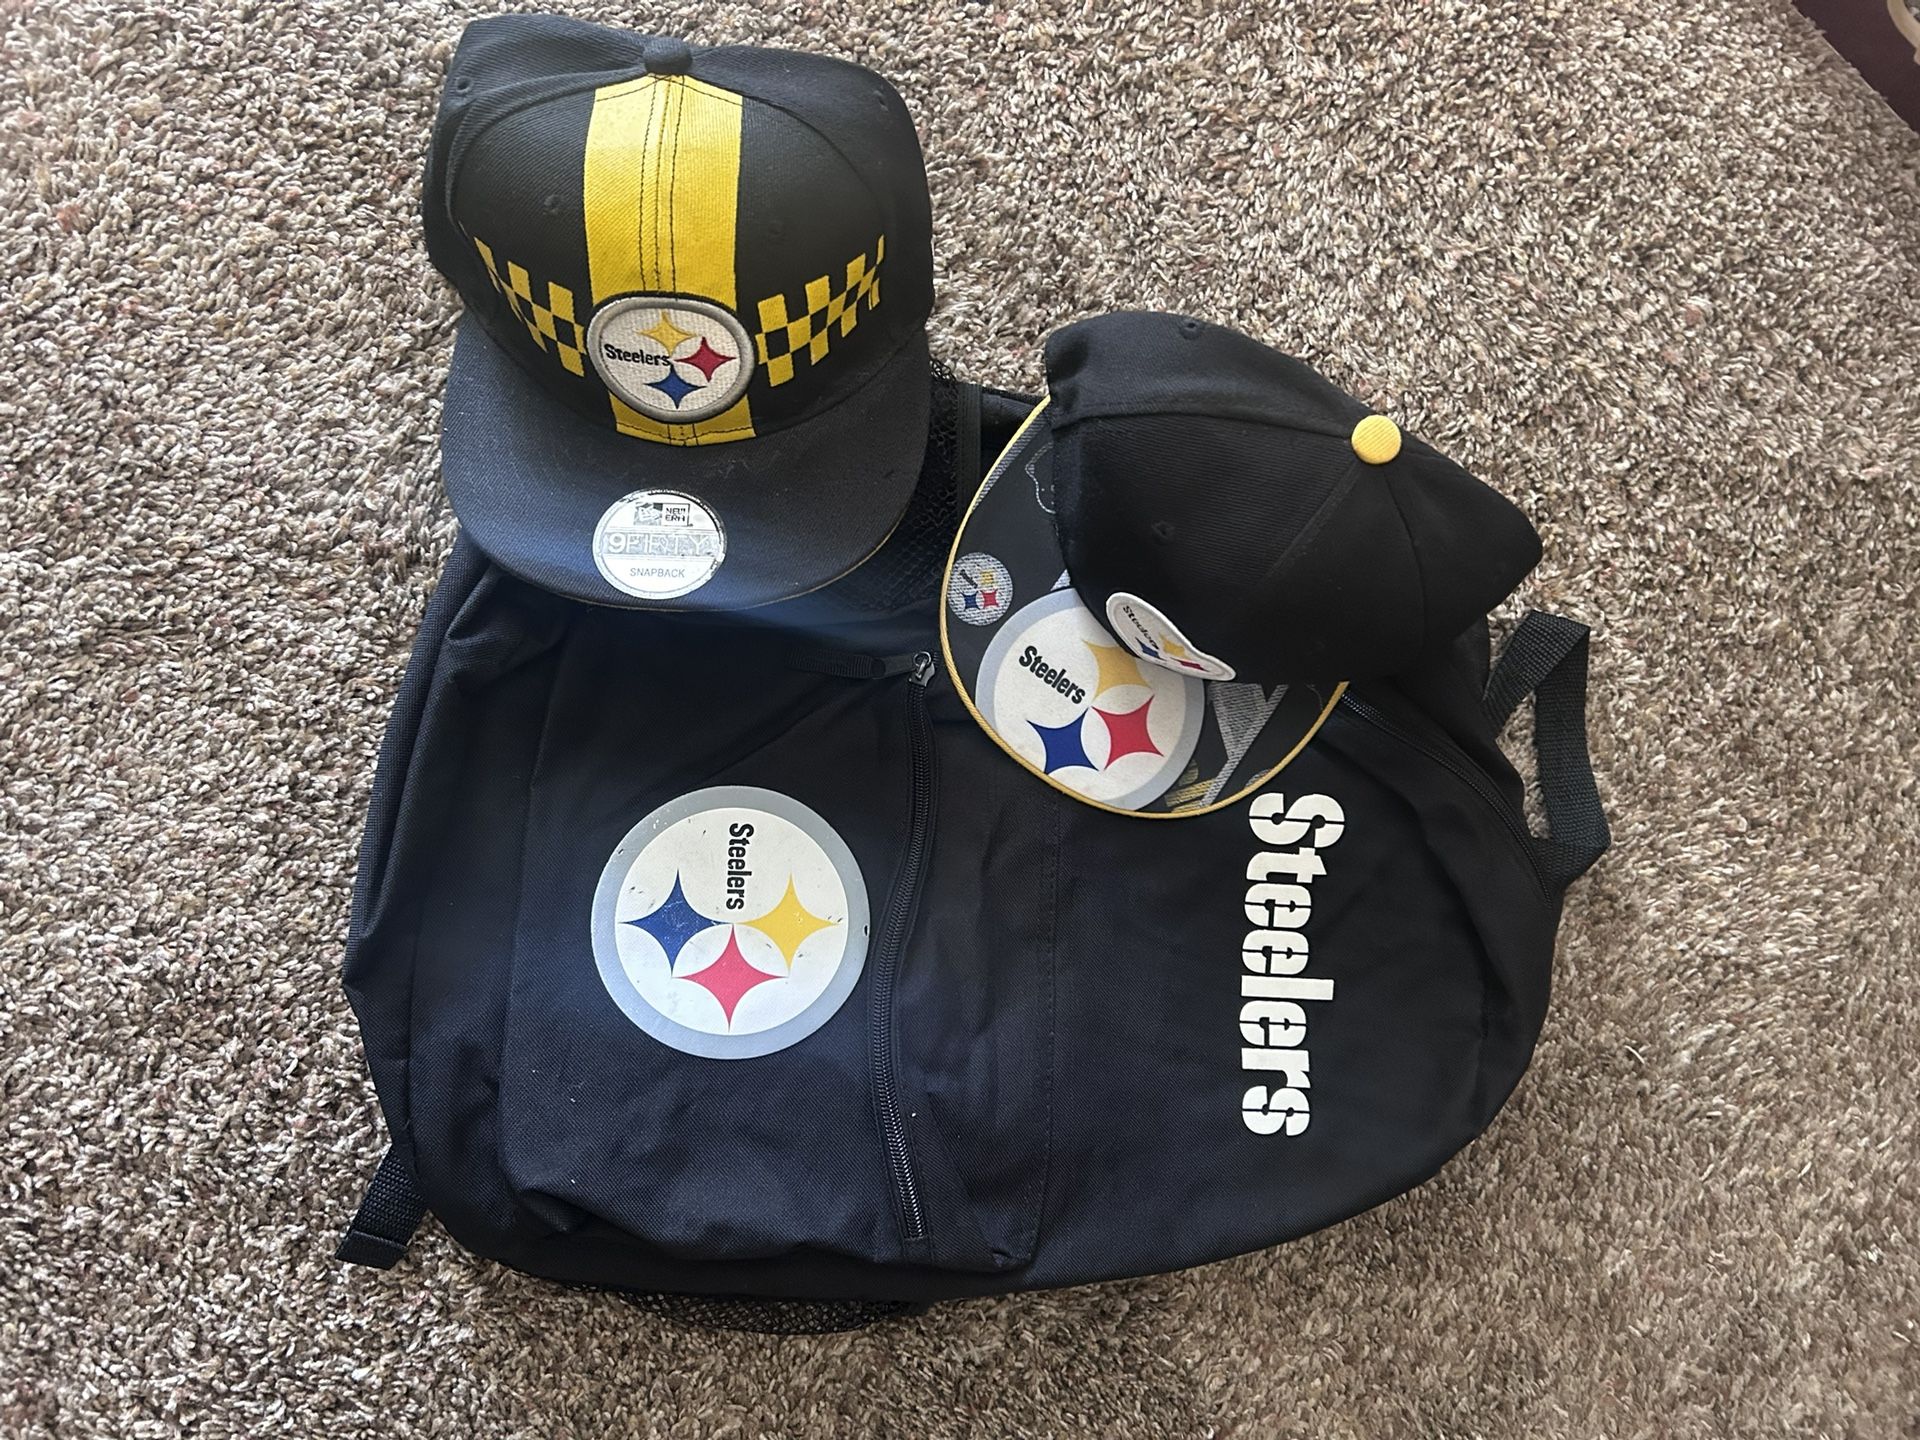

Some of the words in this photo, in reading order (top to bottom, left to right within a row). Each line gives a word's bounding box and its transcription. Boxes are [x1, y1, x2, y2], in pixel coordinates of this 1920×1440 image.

[603, 343, 671, 367] Steelers
[629, 567, 686, 579] SNAPBACK
[1018, 645, 1086, 705] Steelers
[726, 823, 754, 910] Steelers
[1238, 792, 1346, 1137] Steelers
